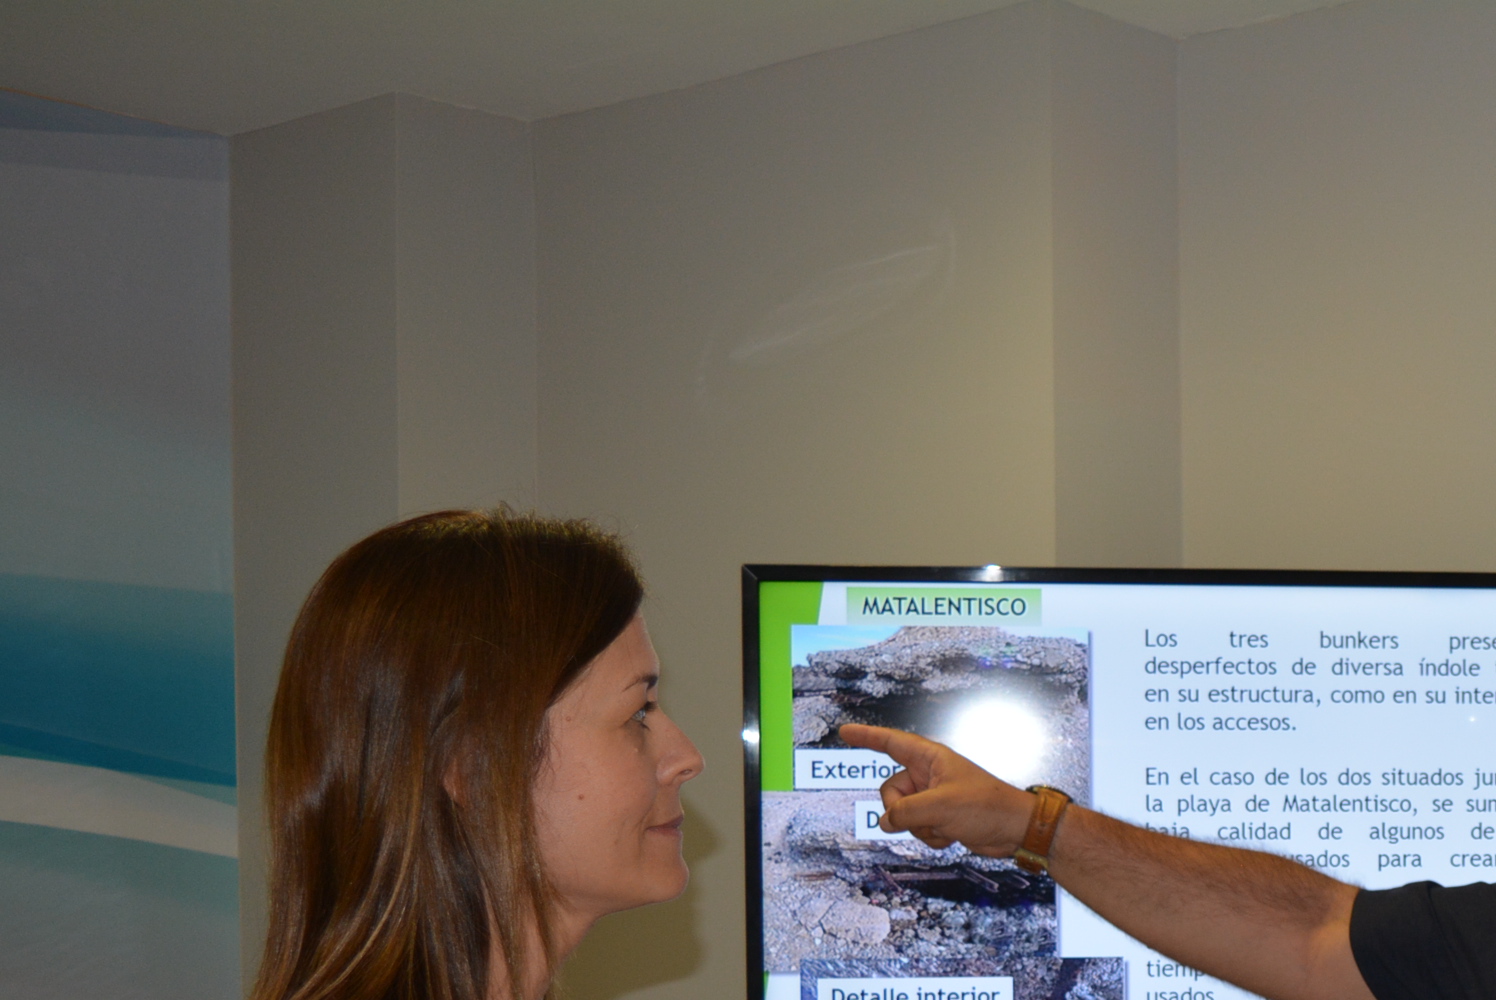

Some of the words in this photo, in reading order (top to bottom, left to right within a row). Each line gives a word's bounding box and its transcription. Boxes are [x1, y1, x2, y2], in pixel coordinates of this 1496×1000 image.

[862, 596, 1027, 617] MATALENTISCO
[1144, 628, 1178, 648] Los
[1228, 630, 1269, 649] tres
[1319, 630, 1400, 650] bunkers
[1144, 655, 1278, 680] desperfectos
[1291, 657, 1317, 676] de
[1331, 657, 1404, 677] diversa
[1418, 657, 1481, 677] índole
[1144, 688, 1170, 703] en
[1177, 688, 1200, 703] su
[1207, 685, 1321, 708] estructura,
[1330, 689, 1386, 704] como
[1392, 689, 1417, 704] en
[1424, 690, 1447, 705] su
[1144, 716, 1170, 731] en
[1177, 711, 1206, 731] los
[1212, 716, 1297, 732] accesos.
[1145, 766, 1170, 786] En
[1179, 767, 1200, 786] el
[1209, 771, 1255, 786] caso
[1264, 767, 1290, 786] de
[1299, 767, 1328, 786] los
[1337, 767, 1372, 786] dos
[1381, 767, 1464, 787] situados
[1145, 793, 1164, 813] la
[1177, 793, 1232, 817] playa
[1244, 794, 1271, 813] de
[1282, 794, 1418, 817] Matalentisco,
[1431, 798, 1454, 813] se
[1215, 821, 1292, 841] calidad
[1317, 821, 1344, 841] de
[1368, 821, 1445, 845] algunos
[1470, 821, 1496, 840] de
[1377, 853, 1423, 872] para
